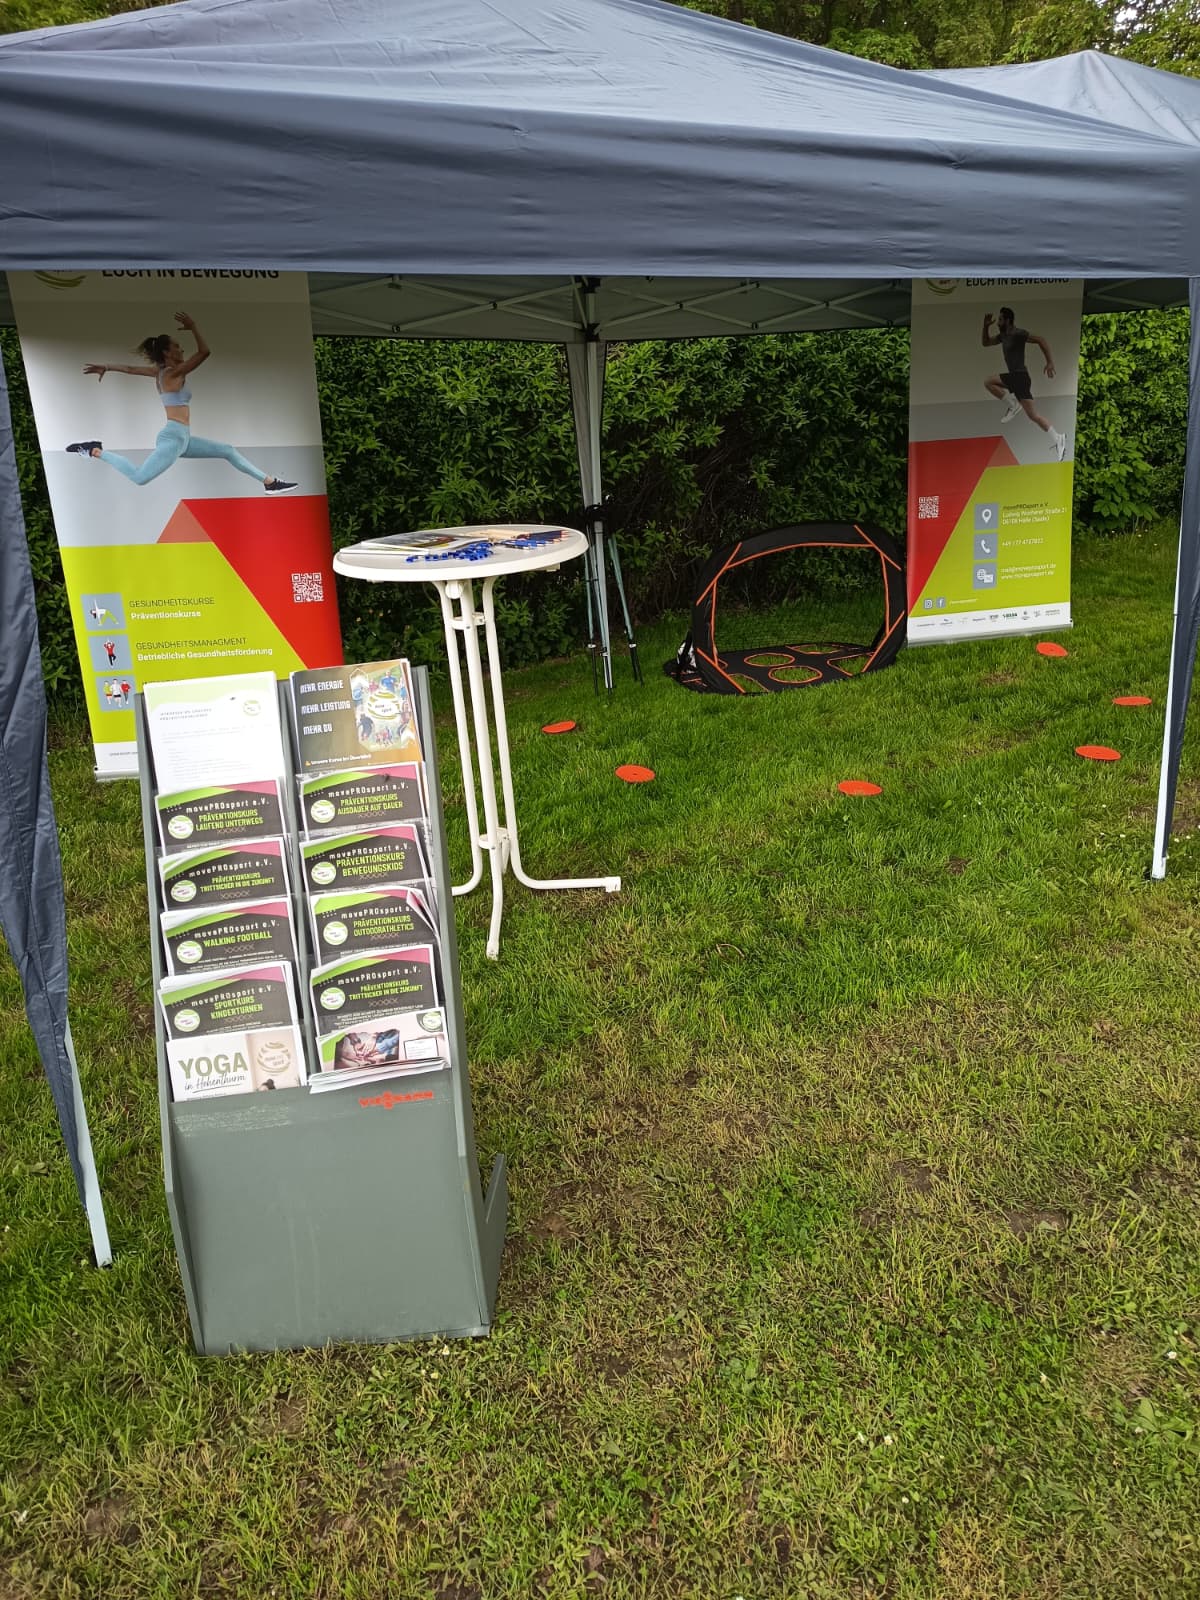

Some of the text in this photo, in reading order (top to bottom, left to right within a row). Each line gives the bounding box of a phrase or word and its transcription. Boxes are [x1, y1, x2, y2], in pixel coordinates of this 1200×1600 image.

[129, 597, 215, 608] GESUNDHEITSKURSE
[131, 610, 202, 620] Präventionskurse
[135, 638, 247, 650] GESUNDHEITSMANAGMENT
[137, 648, 273, 661] Betriebliche Gesundheitsförderung
[301, 700, 351, 715] MEHR LEISTUNG
[303, 725, 322, 736] MEHR
[328, 781, 410, 798] movePROsport e.V.
[186, 797, 270, 814] movePROsport e.V.
[340, 793, 399, 807] PRÄVENTIONSKURS
[198, 808, 258, 823] PRÄVENTIONSKURS
[337, 805, 369, 816] AUSDAUER
[370, 803, 382, 812] AUF
[383, 801, 404, 811] DAUER
[195, 820, 225, 831] LAUFEND
[225, 817, 264, 829] UNTERWEGS
[329, 842, 412, 860] movePROsport e.V.
[188, 858, 273, 877] movePROsport e.V.
[336, 852, 406, 868] PRÄVENTIONSKURS
[342, 862, 404, 877] BEWEGUNGSKIDS
[341, 905, 403, 919] movePROsport
[353, 914, 411, 928] PRÄVENTIONSKURS
[194, 919, 280, 939] movePROsport e.V.
[353, 923, 415, 937] OUTDOORATHLETICS
[203, 930, 272, 948] WALKING FOOTBALL
[338, 965, 421, 985] movePROsport e.V.
[191, 987, 255, 1007] movePROsport
[214, 995, 256, 1010] SPORTKURS
[210, 1003, 264, 1020] KINDERTURNEN
[178, 1051, 248, 1080] YOGA
[184, 1072, 247, 1092] in Hohenthurm
